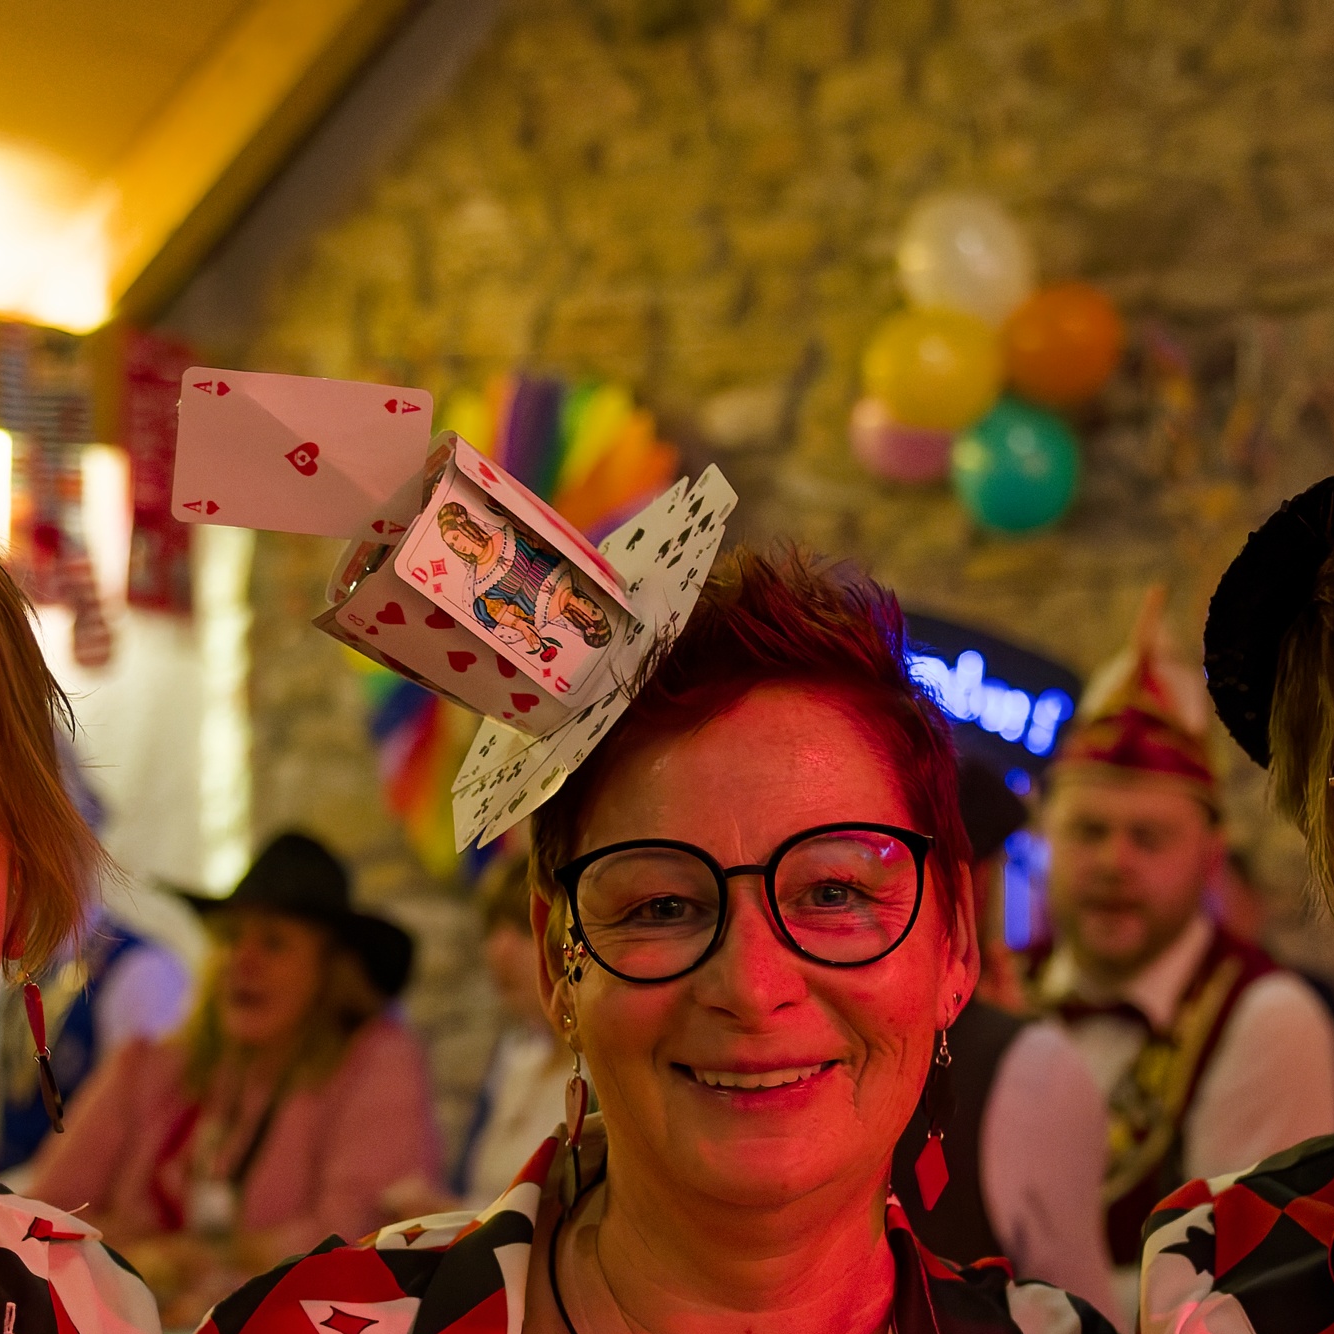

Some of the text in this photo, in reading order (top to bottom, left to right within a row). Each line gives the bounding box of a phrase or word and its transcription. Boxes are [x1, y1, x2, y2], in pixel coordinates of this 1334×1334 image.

[192, 381, 213, 395] A
[402, 400, 422, 415] A
[182, 500, 203, 514] A
[388, 520, 408, 535] A
[411, 567, 429, 586] D
[347, 613, 365, 627] 8
[554, 676, 572, 693] D
